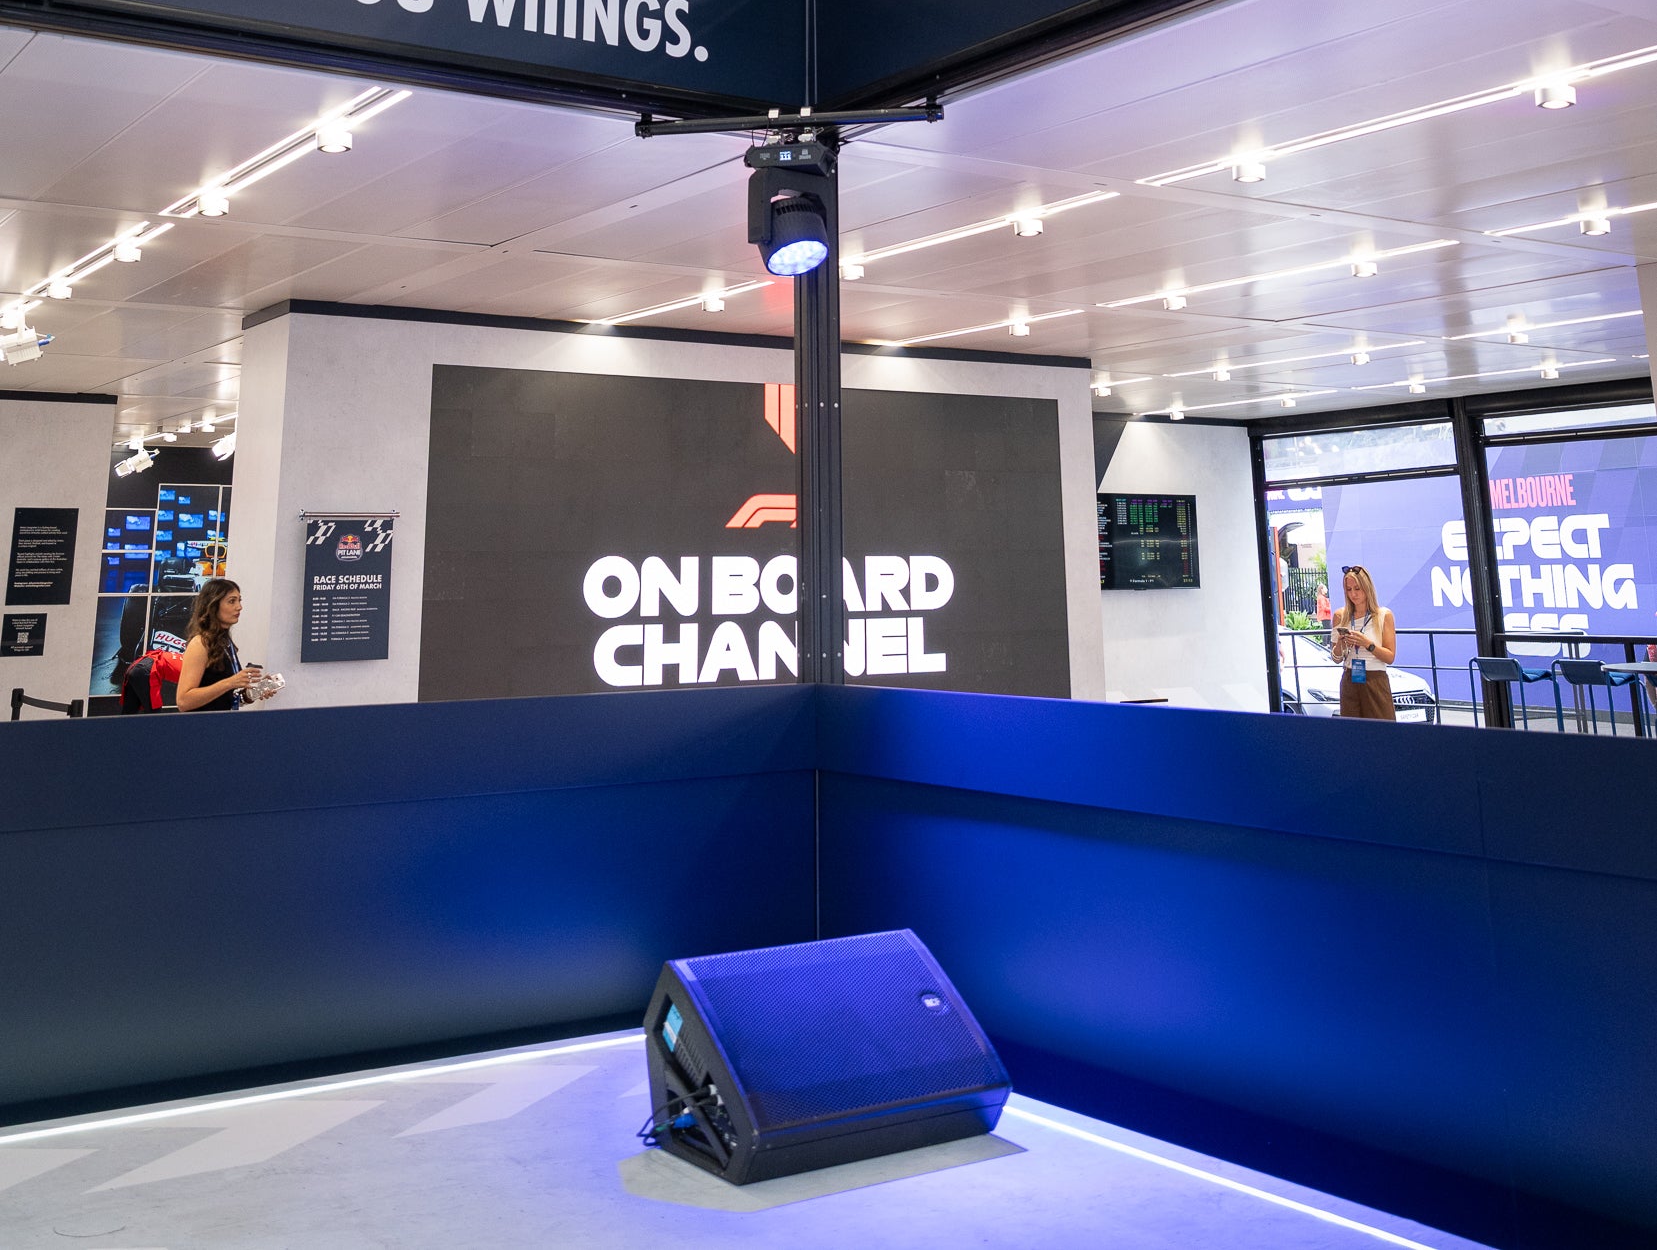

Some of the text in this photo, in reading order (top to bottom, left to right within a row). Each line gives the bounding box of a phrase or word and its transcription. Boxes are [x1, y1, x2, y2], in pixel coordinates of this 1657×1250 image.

[1489, 474, 1576, 509] MELBOURNE
[313, 575, 382, 583] RACE SCHEDULE
